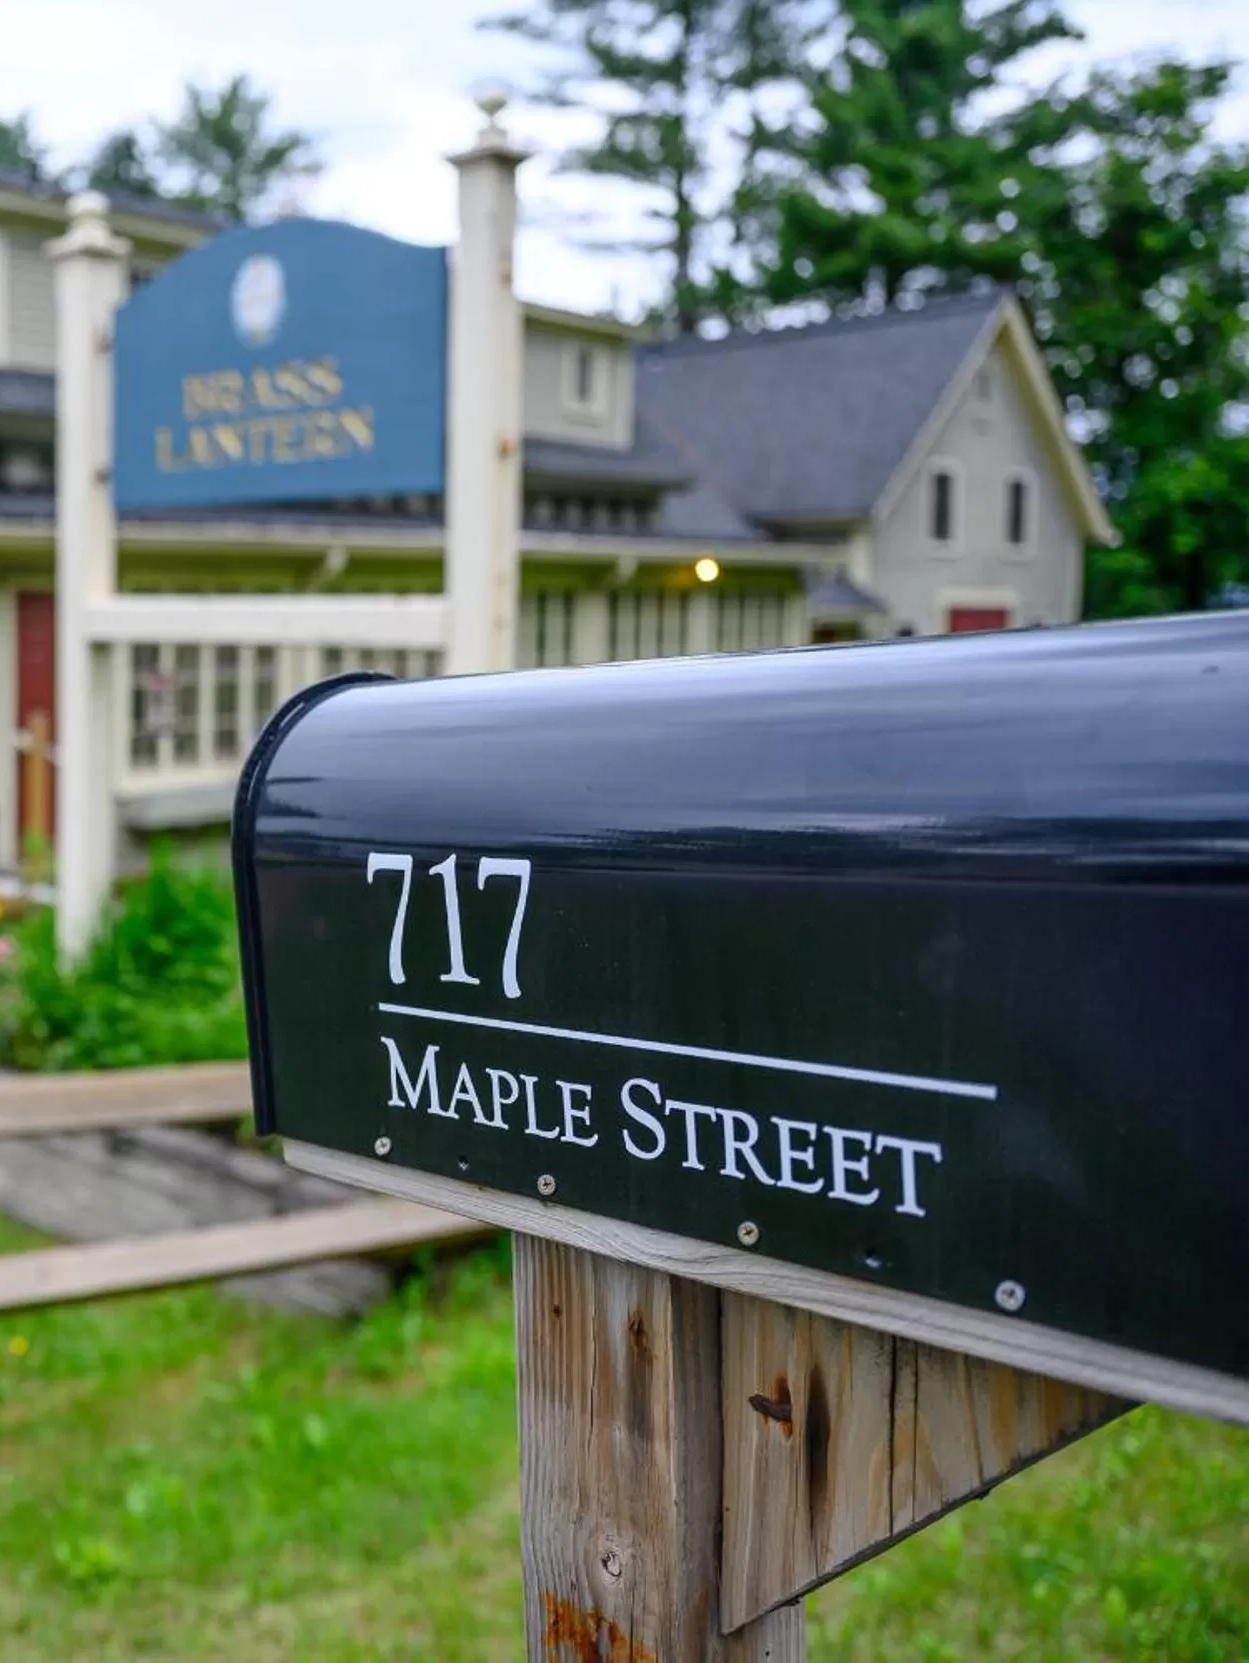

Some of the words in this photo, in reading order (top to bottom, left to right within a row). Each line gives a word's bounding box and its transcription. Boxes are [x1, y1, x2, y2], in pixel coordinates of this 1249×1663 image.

[367, 852, 532, 999] 717
[381, 1036, 599, 1148] MAPLE
[621, 1078, 942, 1217] STREET
